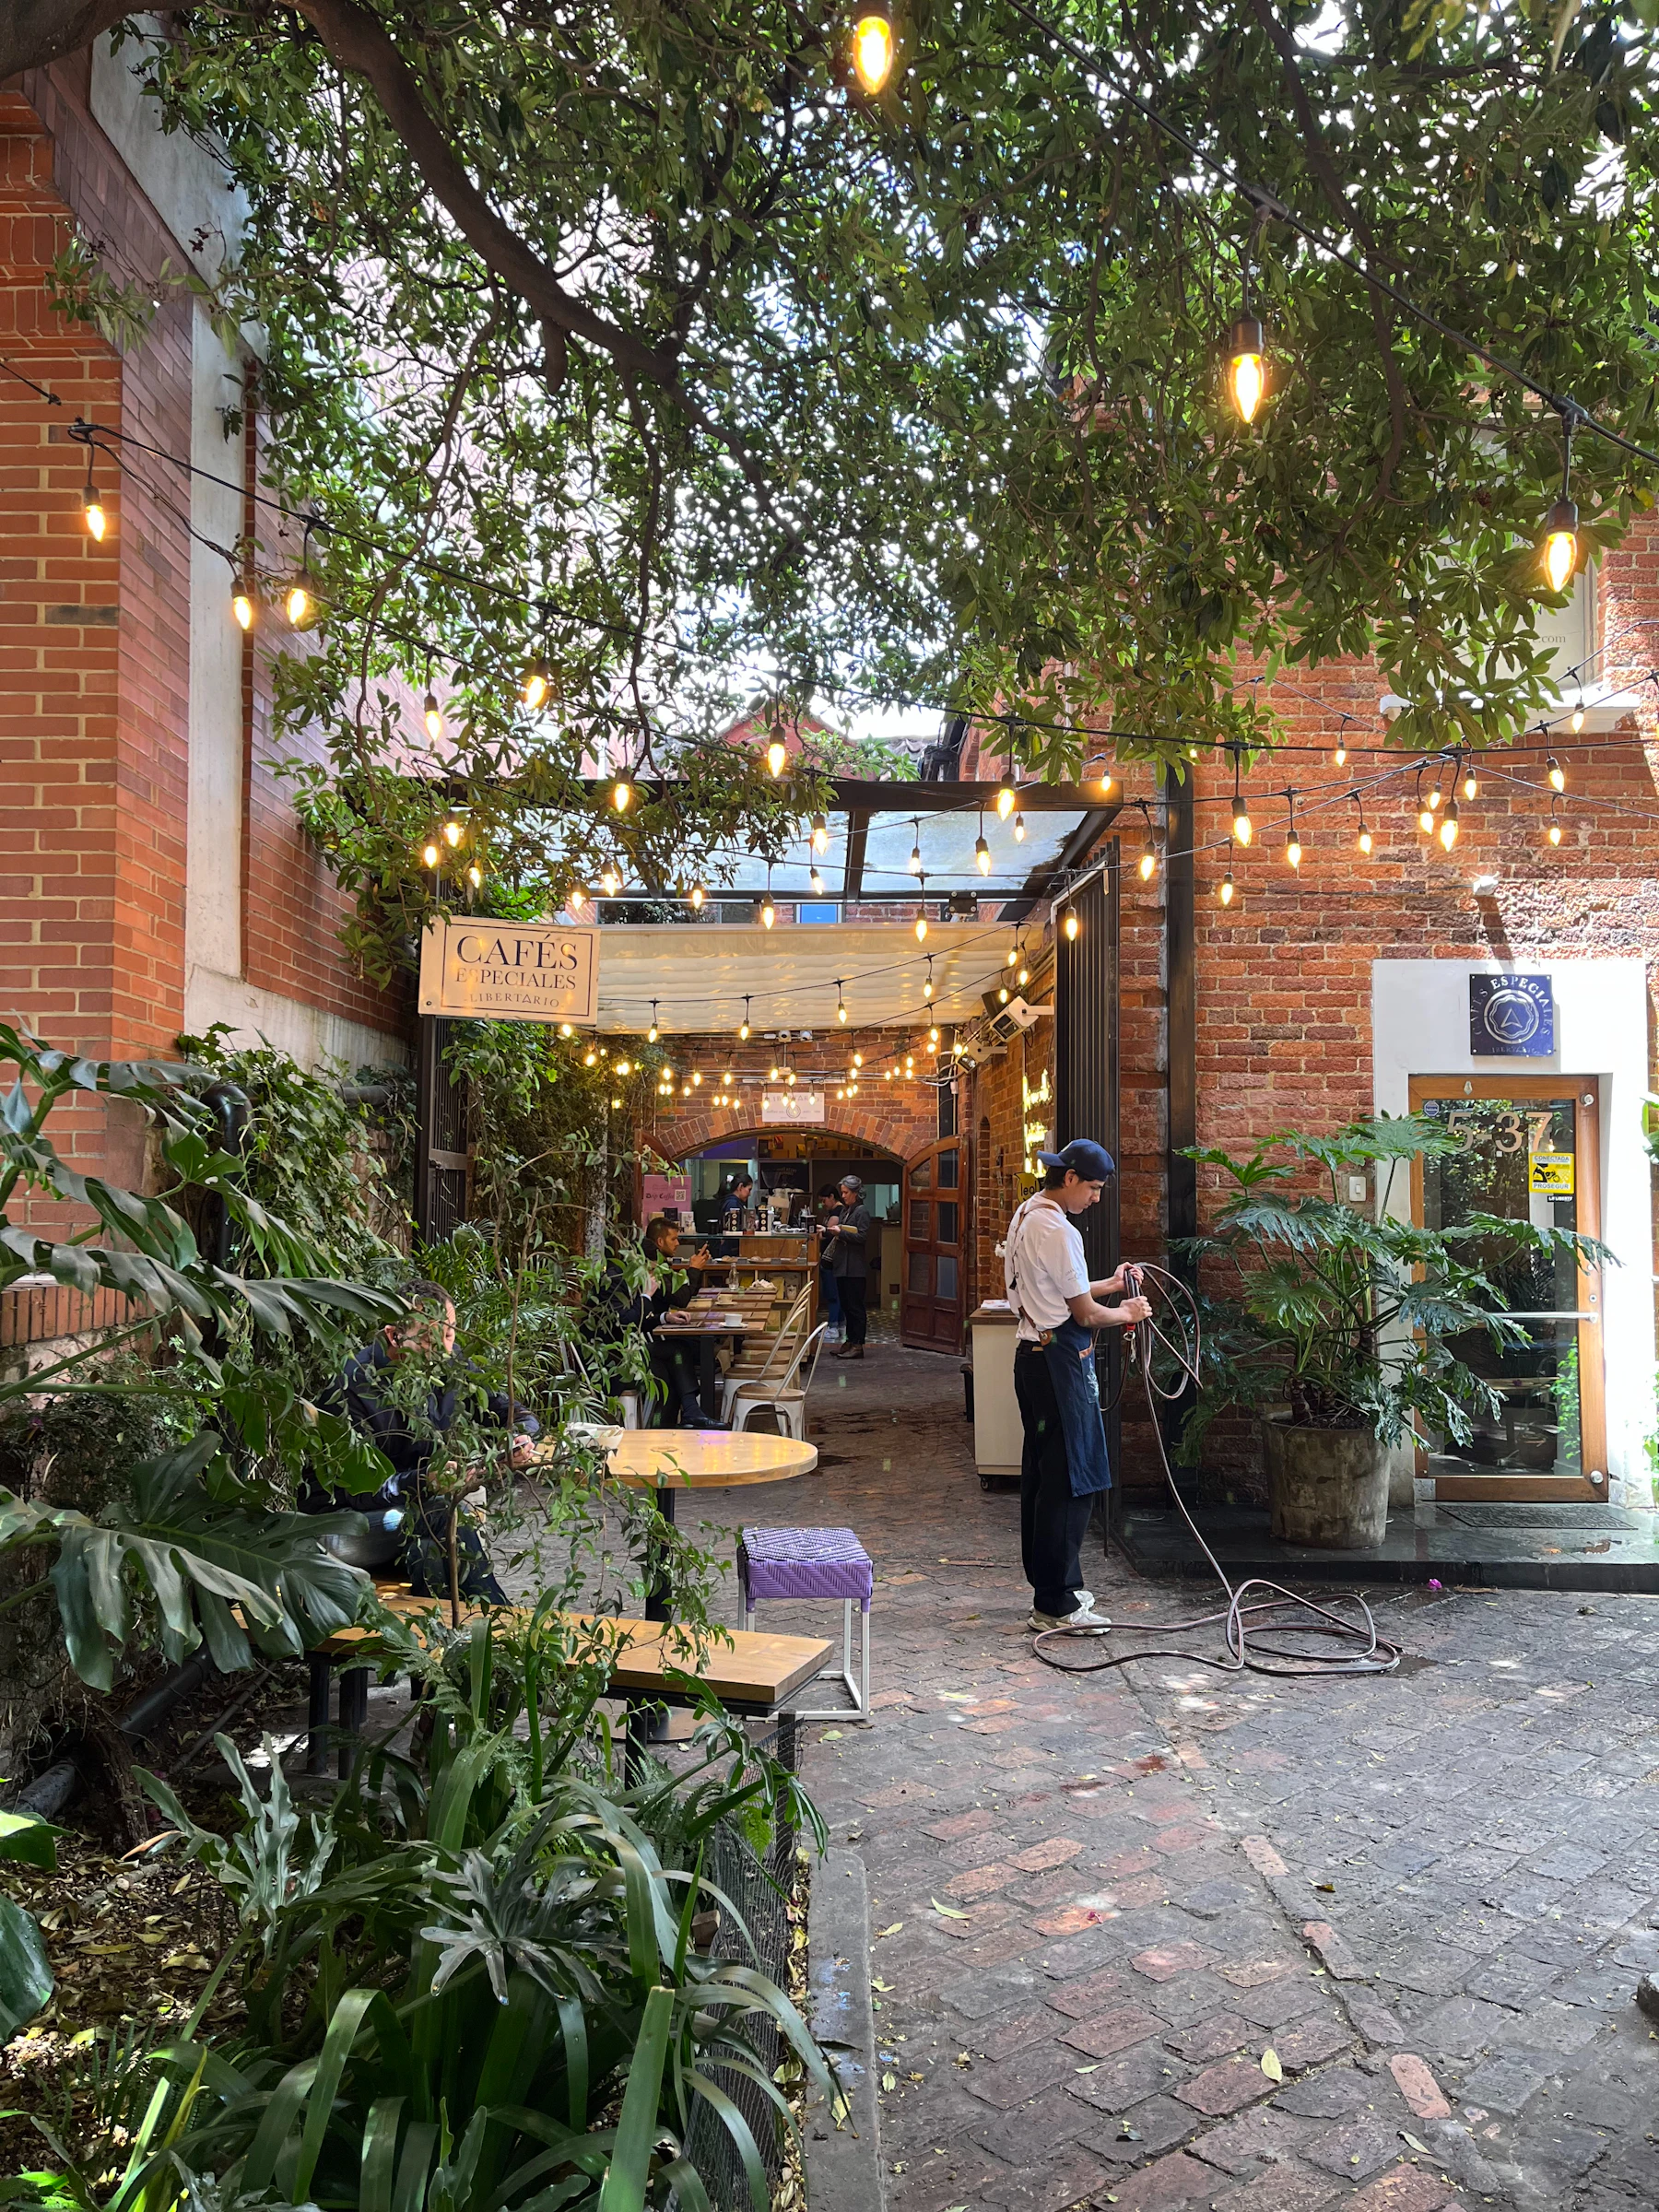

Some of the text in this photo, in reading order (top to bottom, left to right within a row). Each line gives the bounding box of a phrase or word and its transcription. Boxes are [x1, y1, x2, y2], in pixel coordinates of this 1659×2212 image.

[456, 933, 578, 971] CAFÉS
[455, 967, 576, 990] ESPECIALES
[1489, 975, 1553, 1036] ESPECIALES
[1446, 1111, 1553, 1153] 5-37
